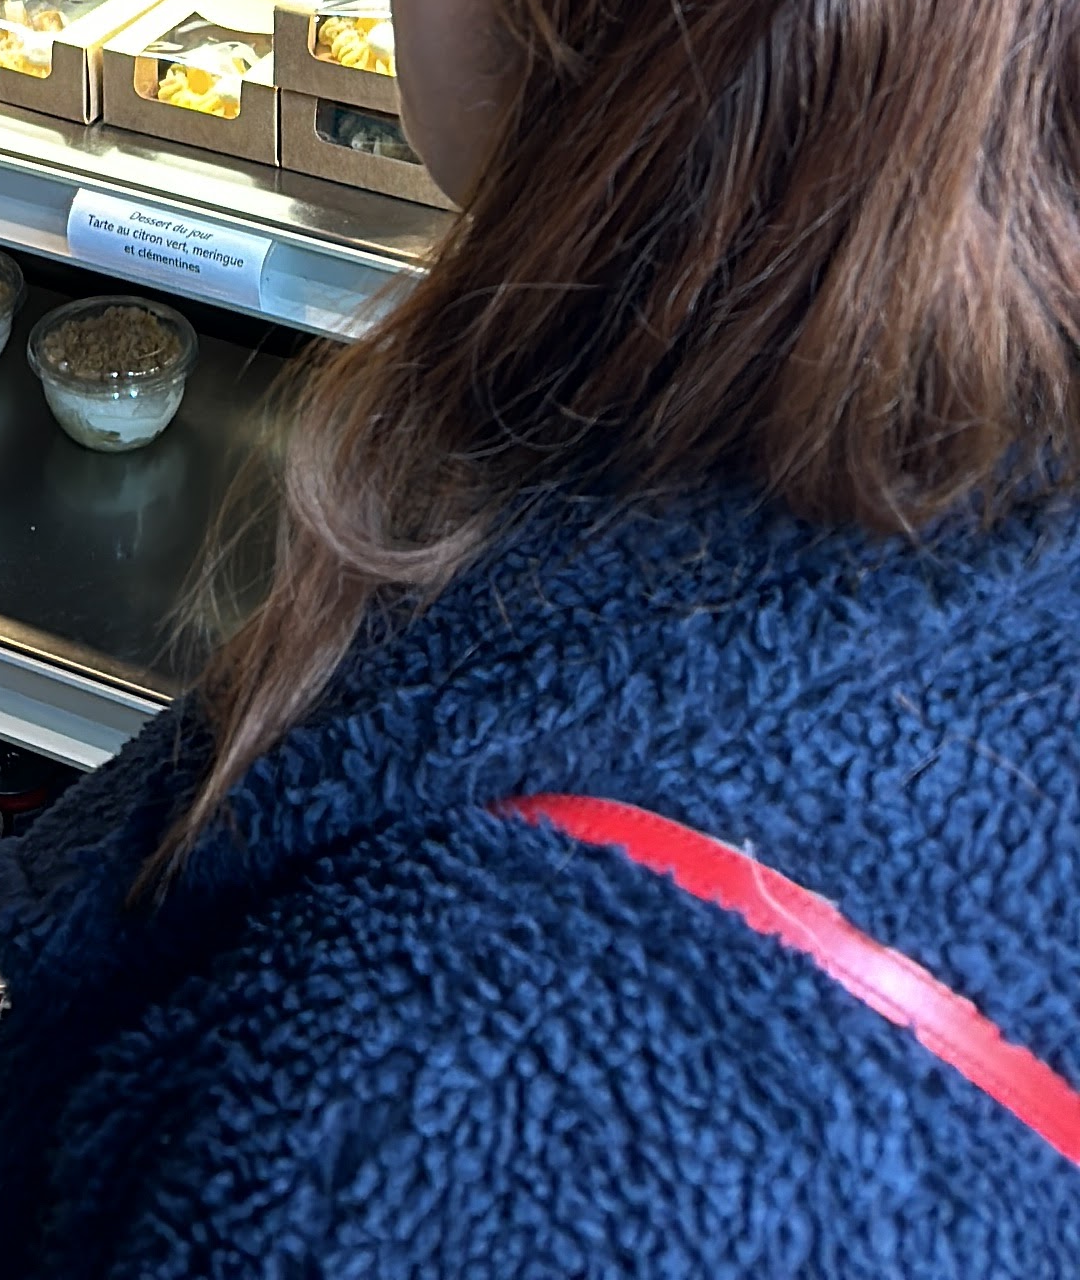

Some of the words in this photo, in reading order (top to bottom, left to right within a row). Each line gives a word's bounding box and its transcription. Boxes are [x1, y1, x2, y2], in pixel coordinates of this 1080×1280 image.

[88, 214, 114, 232] Tarte
[117, 224, 130, 236] au
[133, 228, 163, 245] citron
[166, 237, 189, 255] vert,
[193, 246, 244, 268] meringue
[129, 211, 172, 229] Dessert
[173, 222, 188, 234] du
[187, 227, 214, 241] jour
[124, 244, 134, 255] et
[138, 247, 201, 274] clémentines
